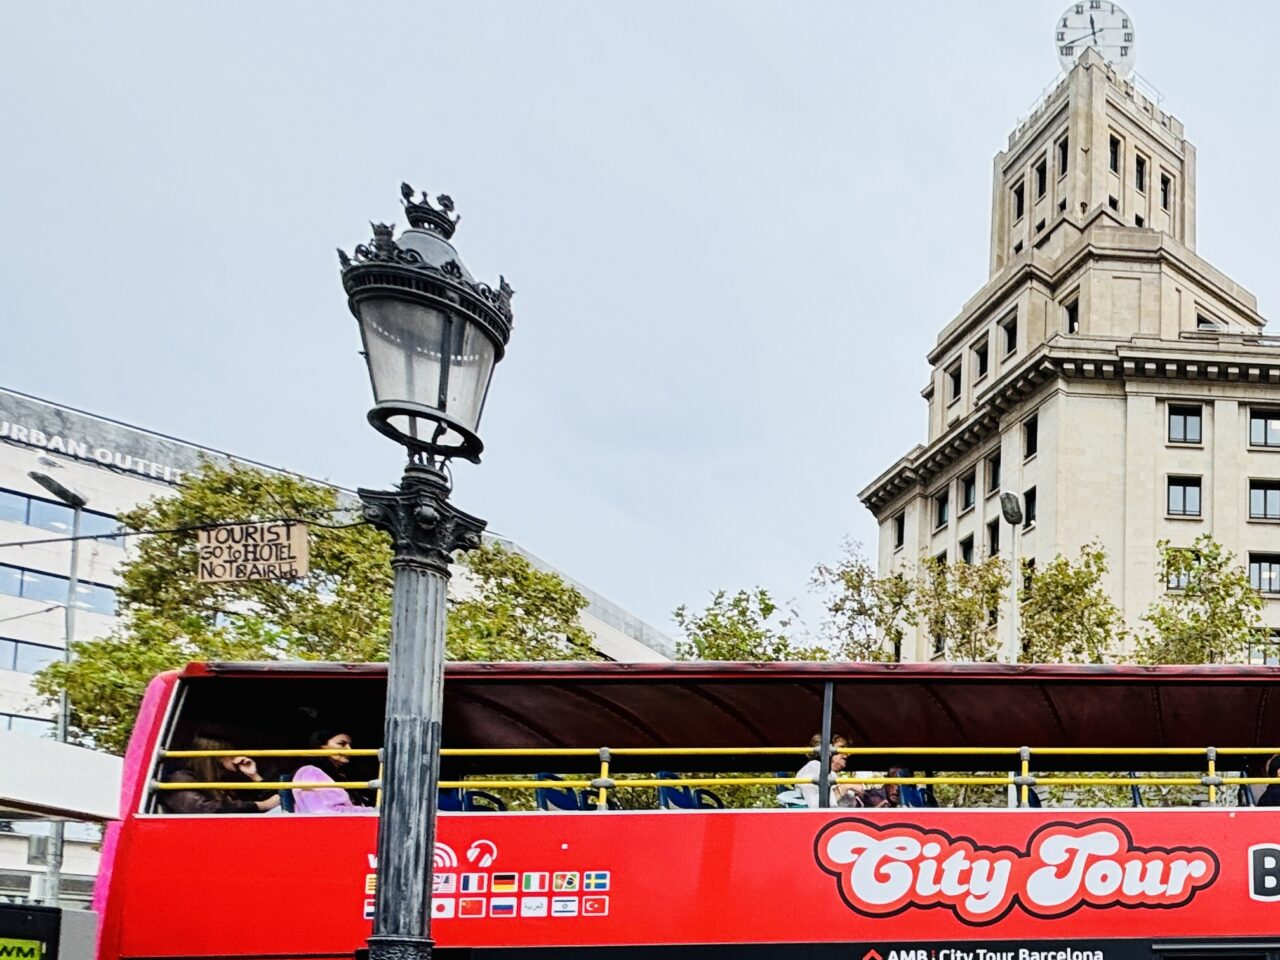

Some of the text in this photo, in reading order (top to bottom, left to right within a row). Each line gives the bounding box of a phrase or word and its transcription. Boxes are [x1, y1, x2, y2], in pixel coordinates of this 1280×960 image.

[201, 545, 223, 560] GO
[242, 543, 296, 562] HOTEL
[826, 830, 1207, 914] City Tour
